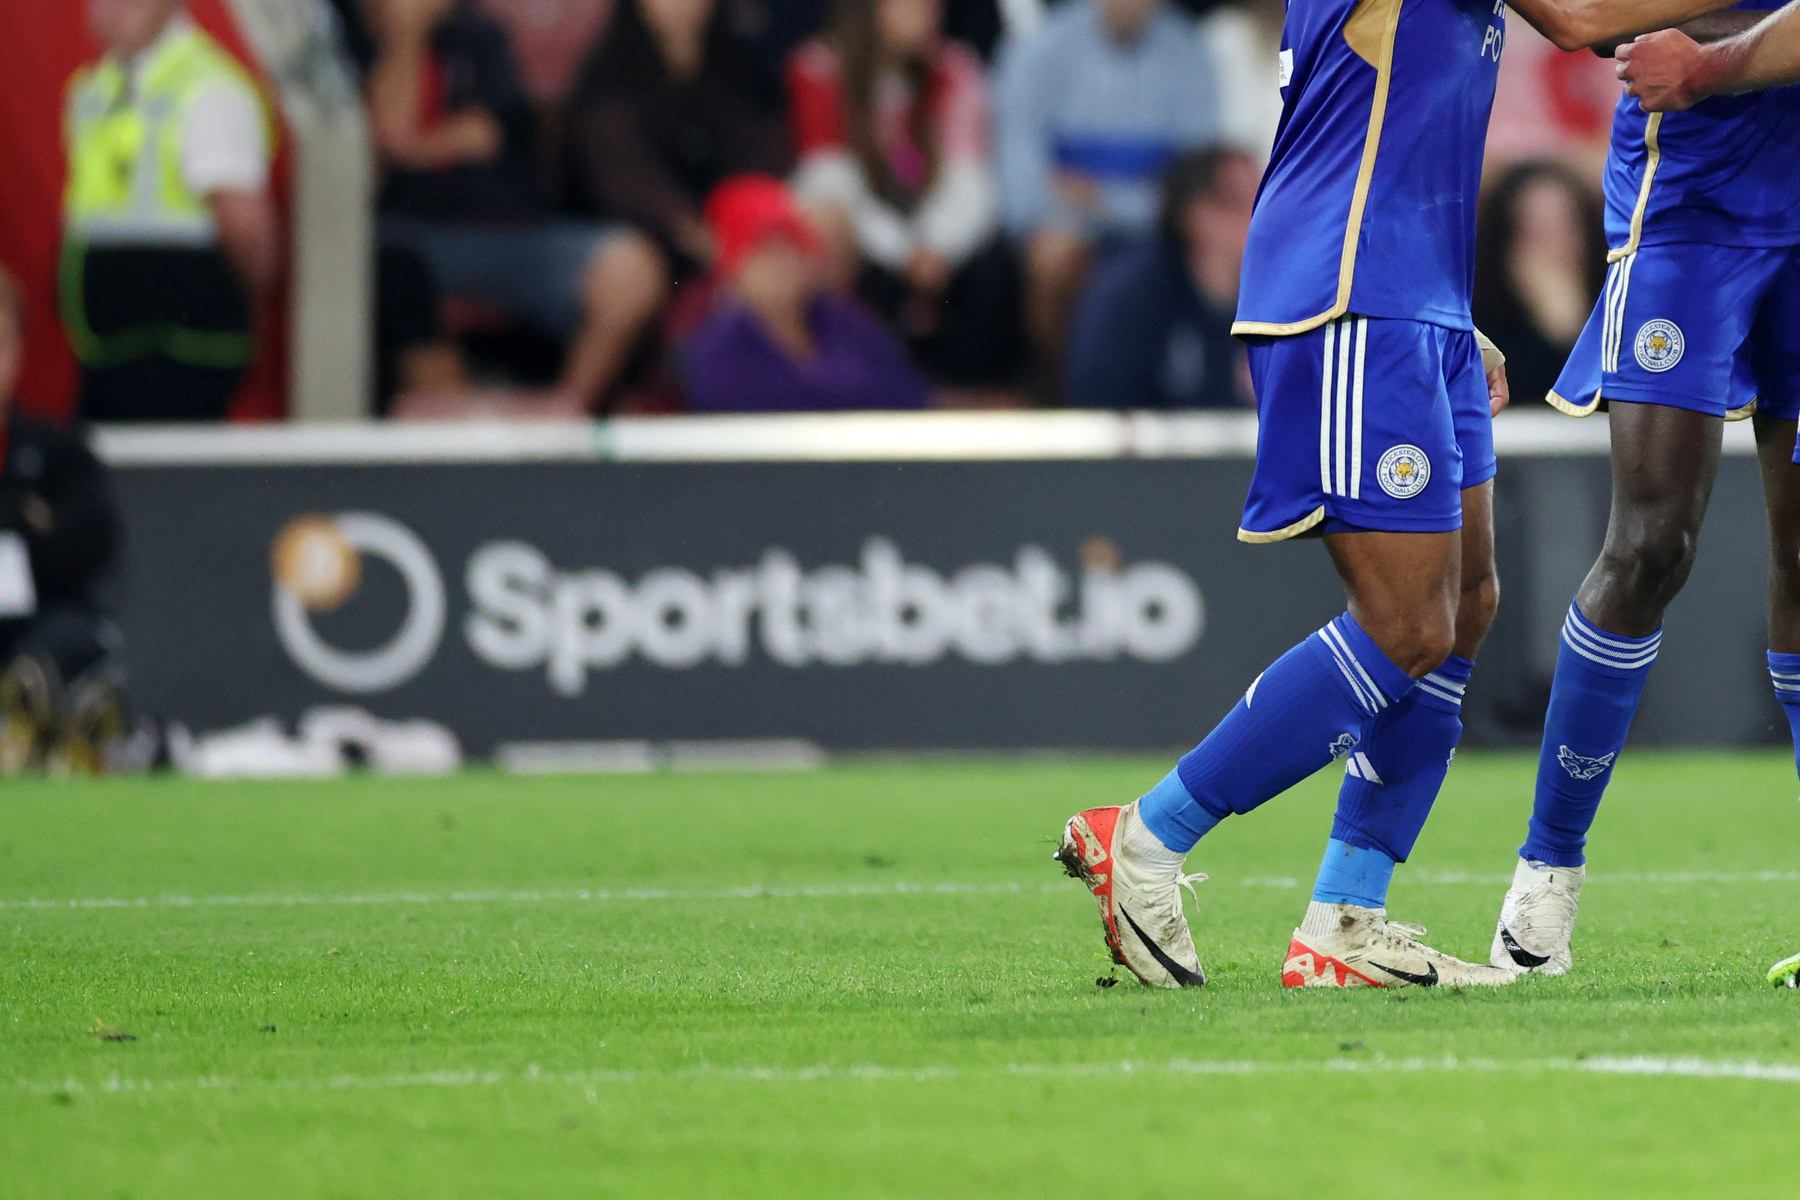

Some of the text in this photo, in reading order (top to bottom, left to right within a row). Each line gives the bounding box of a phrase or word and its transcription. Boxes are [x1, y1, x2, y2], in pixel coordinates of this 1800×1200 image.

[1481, 25, 1506, 63] PO
[1640, 324, 1680, 346] LEICESTER CITY
[1383, 450, 1426, 470] LEICESTER CITY
[1382, 473, 1425, 493] FOOTBALL CLUB
[464, 535, 1203, 696] Sportsbet.io
